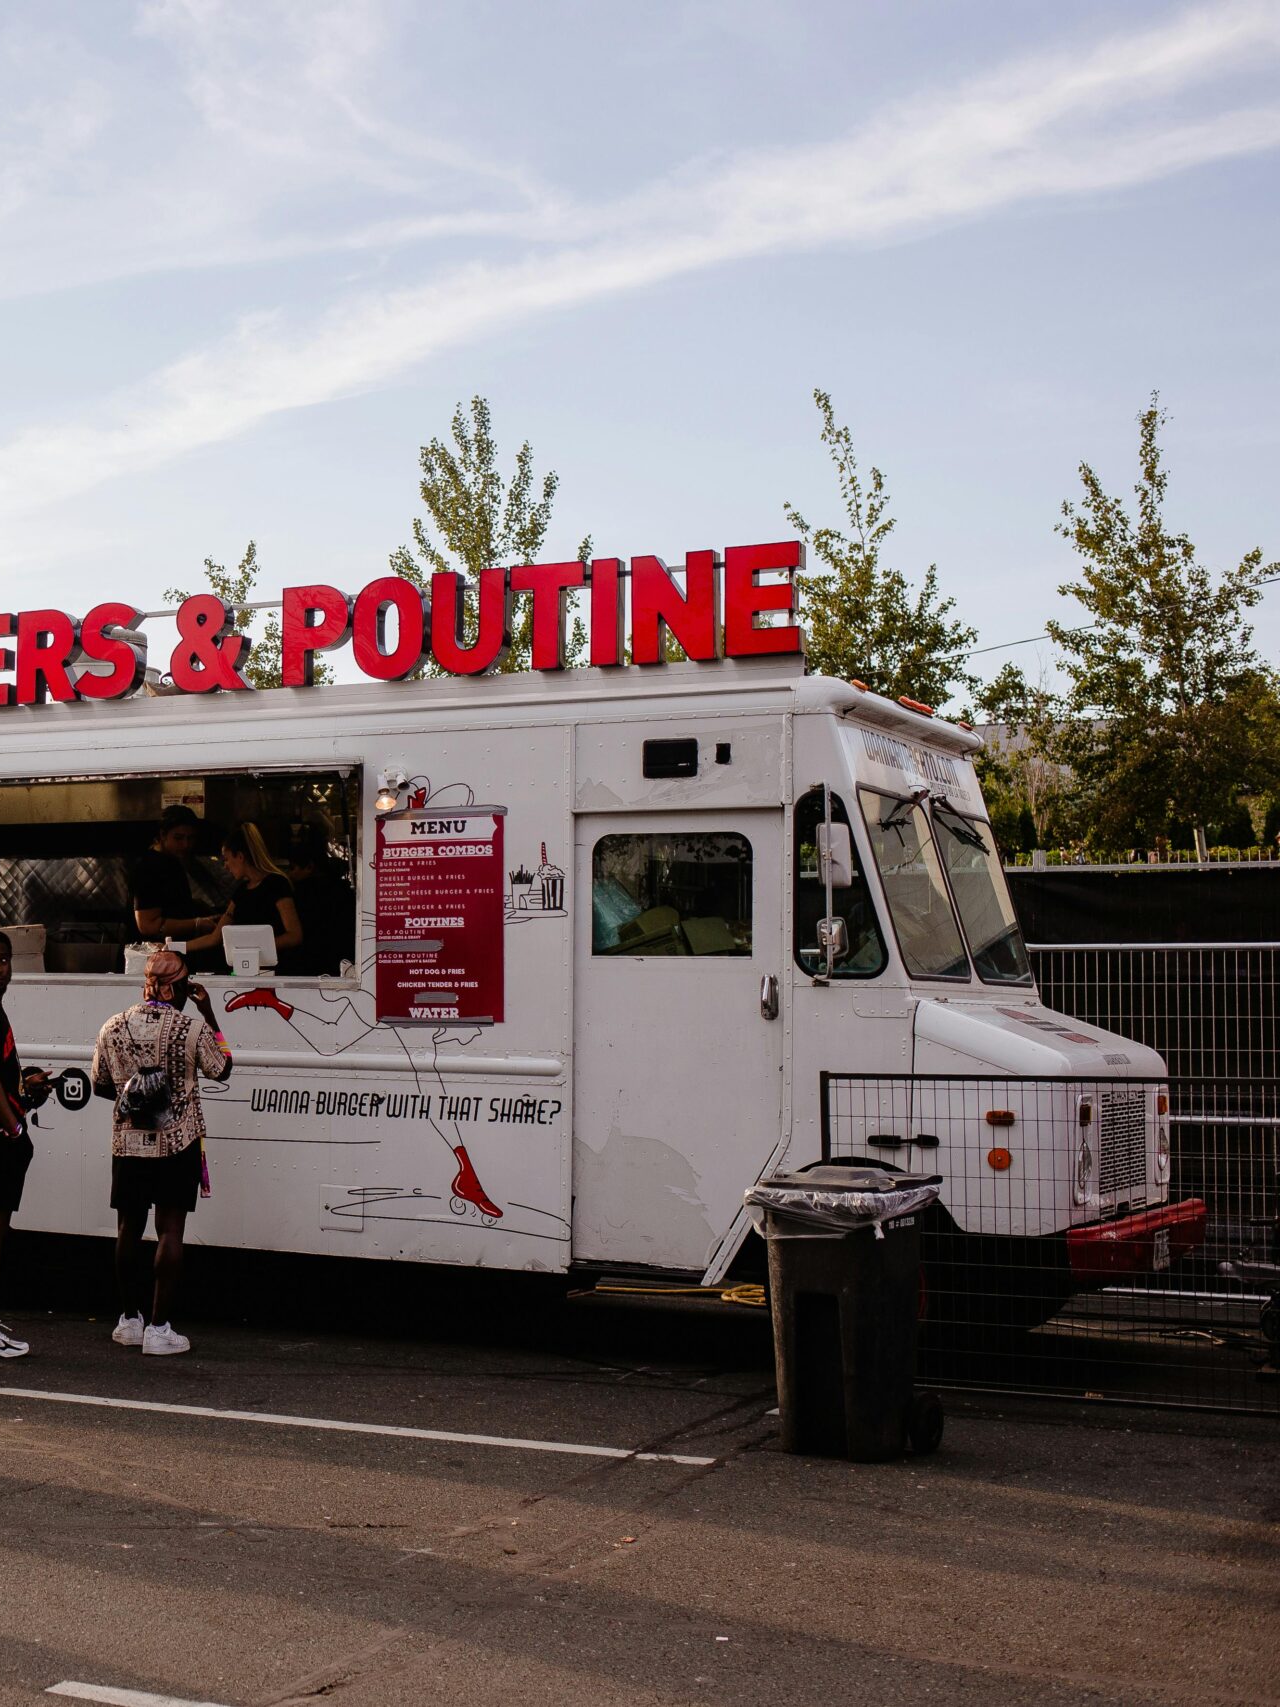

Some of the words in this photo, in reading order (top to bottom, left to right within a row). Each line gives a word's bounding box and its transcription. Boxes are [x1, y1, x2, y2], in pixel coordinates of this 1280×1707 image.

[170, 593, 255, 694] &
[281, 540, 806, 687] POUTINE
[410, 820, 467, 835] MENU
[382, 846, 434, 859] BURGER
[437, 844, 494, 857] COMBOS
[404, 917, 465, 927] POUTINES
[409, 1007, 459, 1018] WATER
[250, 1088, 310, 1113] WANNA
[315, 1091, 379, 1117] BURGER
[386, 1093, 430, 1120] WITH
[438, 1095, 483, 1121] THAT
